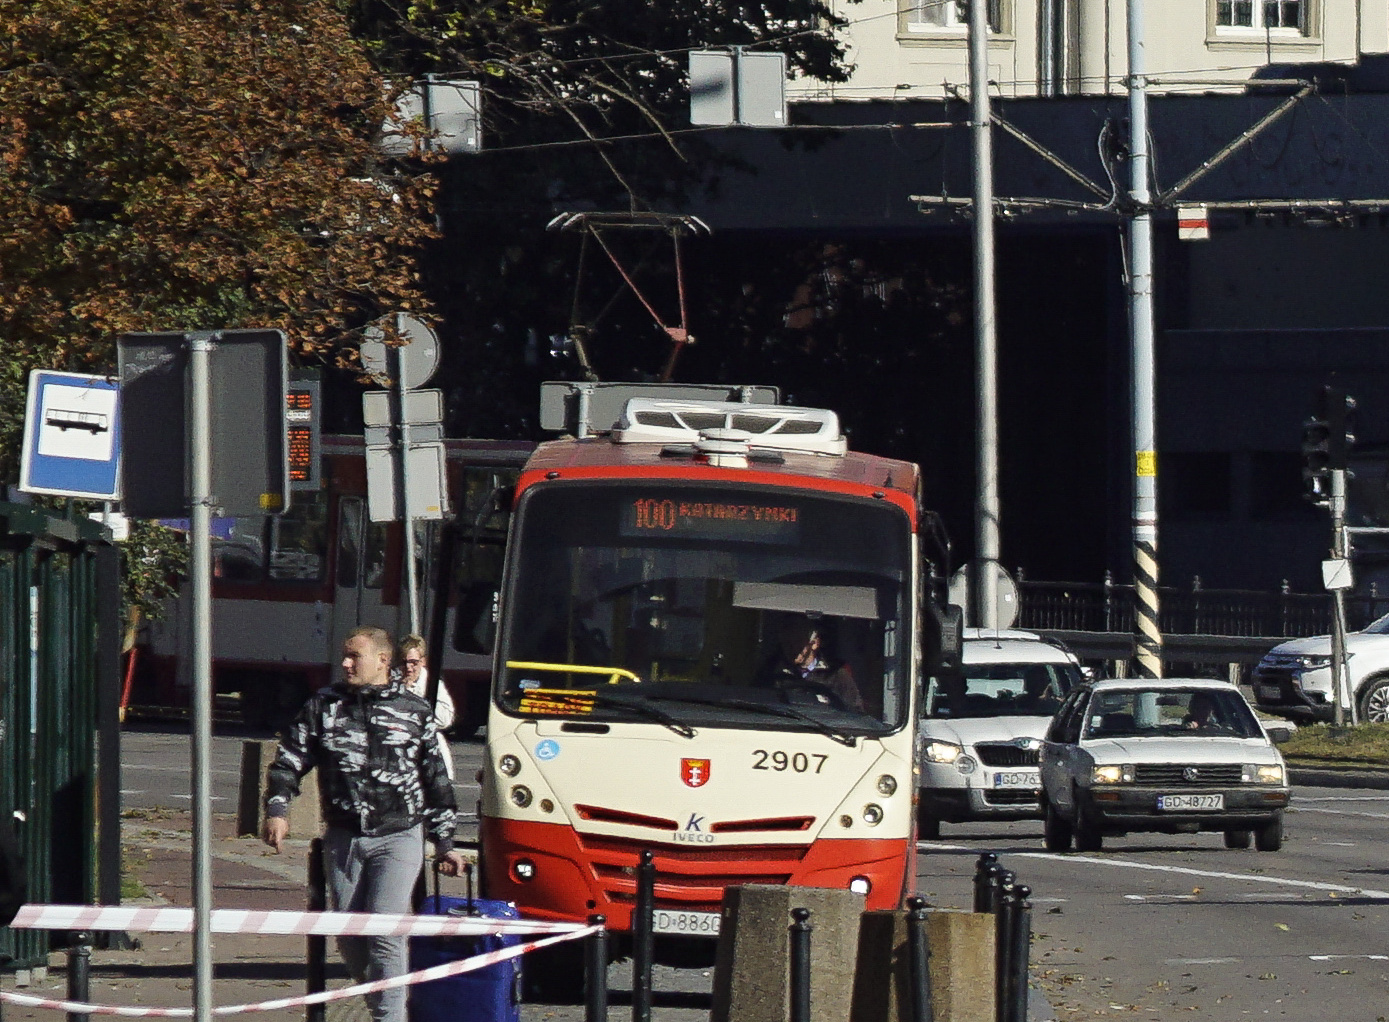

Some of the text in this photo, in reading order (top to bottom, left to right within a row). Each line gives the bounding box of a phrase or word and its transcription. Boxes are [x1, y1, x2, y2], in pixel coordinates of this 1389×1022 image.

[634, 499, 677, 530] 100
[752, 749, 829, 774] 2907
[1164, 796, 1181, 808] GD
[684, 813, 704, 832] K
[672, 832, 715, 844] IVECO
